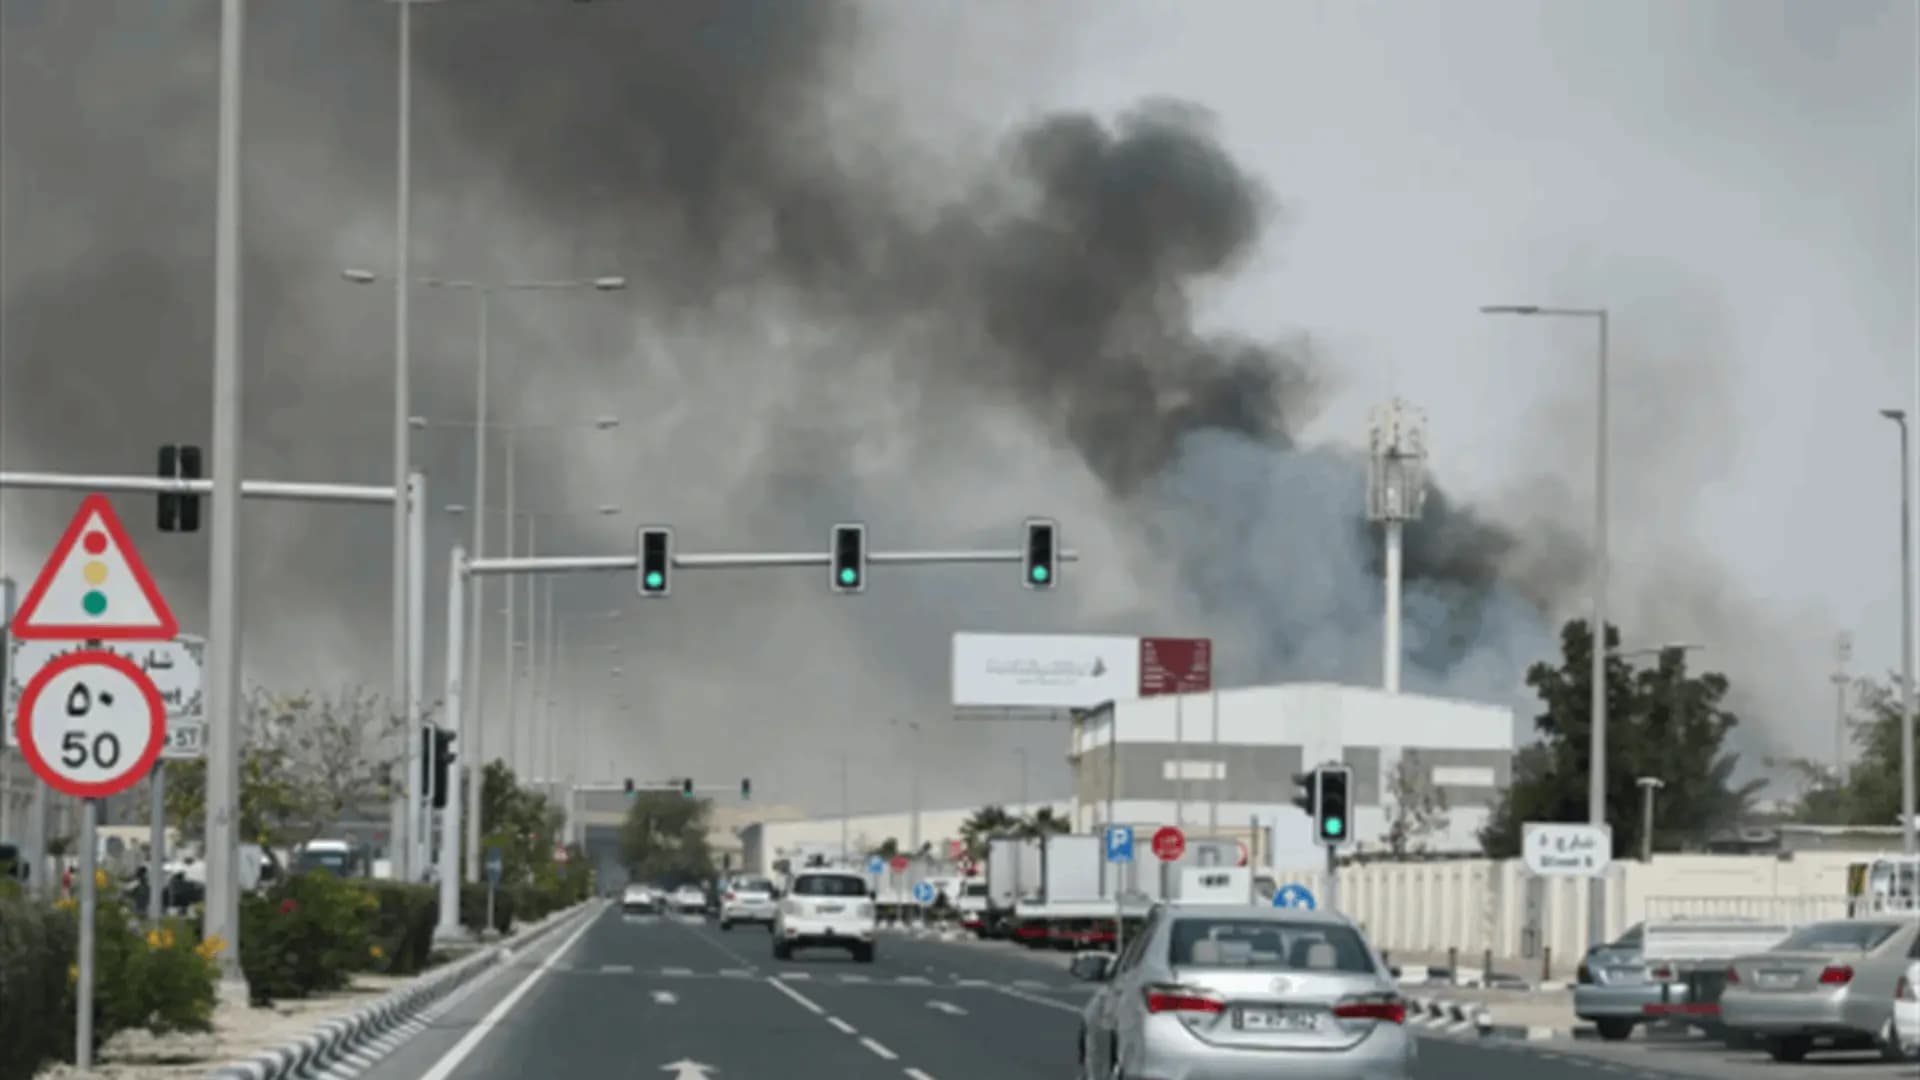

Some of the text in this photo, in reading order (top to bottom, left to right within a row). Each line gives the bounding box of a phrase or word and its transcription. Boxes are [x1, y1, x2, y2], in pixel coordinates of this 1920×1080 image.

[66, 681, 114, 717] ٥٠
[62, 731, 120, 769] 50
[1112, 829, 1128, 849] P
